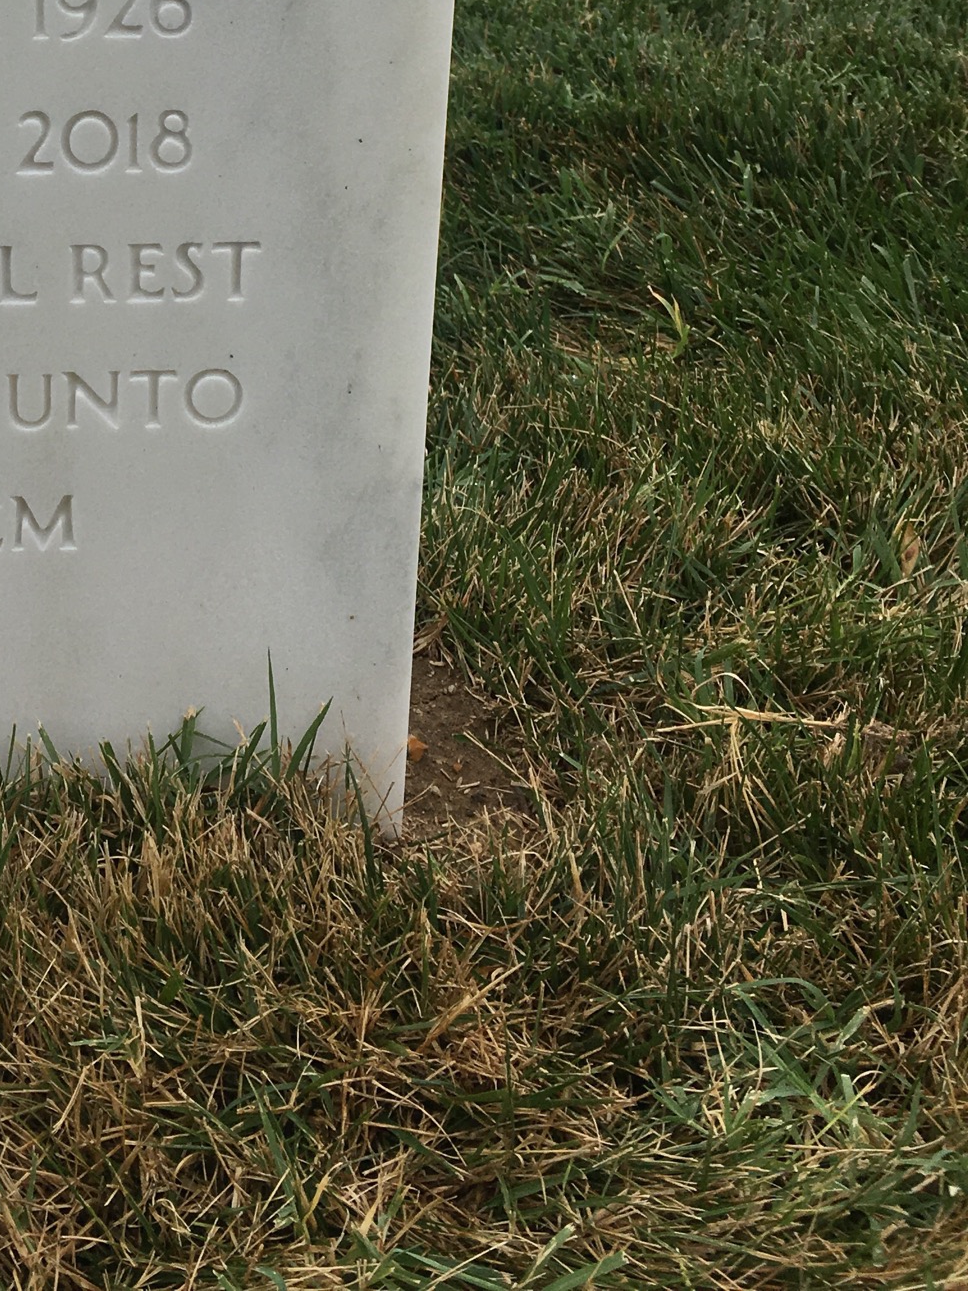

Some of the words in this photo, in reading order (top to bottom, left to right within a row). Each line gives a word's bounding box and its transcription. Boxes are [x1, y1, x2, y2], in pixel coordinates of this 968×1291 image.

[16, 109, 194, 177] 2018
[67, 240, 261, 307] REST
[6, 367, 244, 431] UNTO
